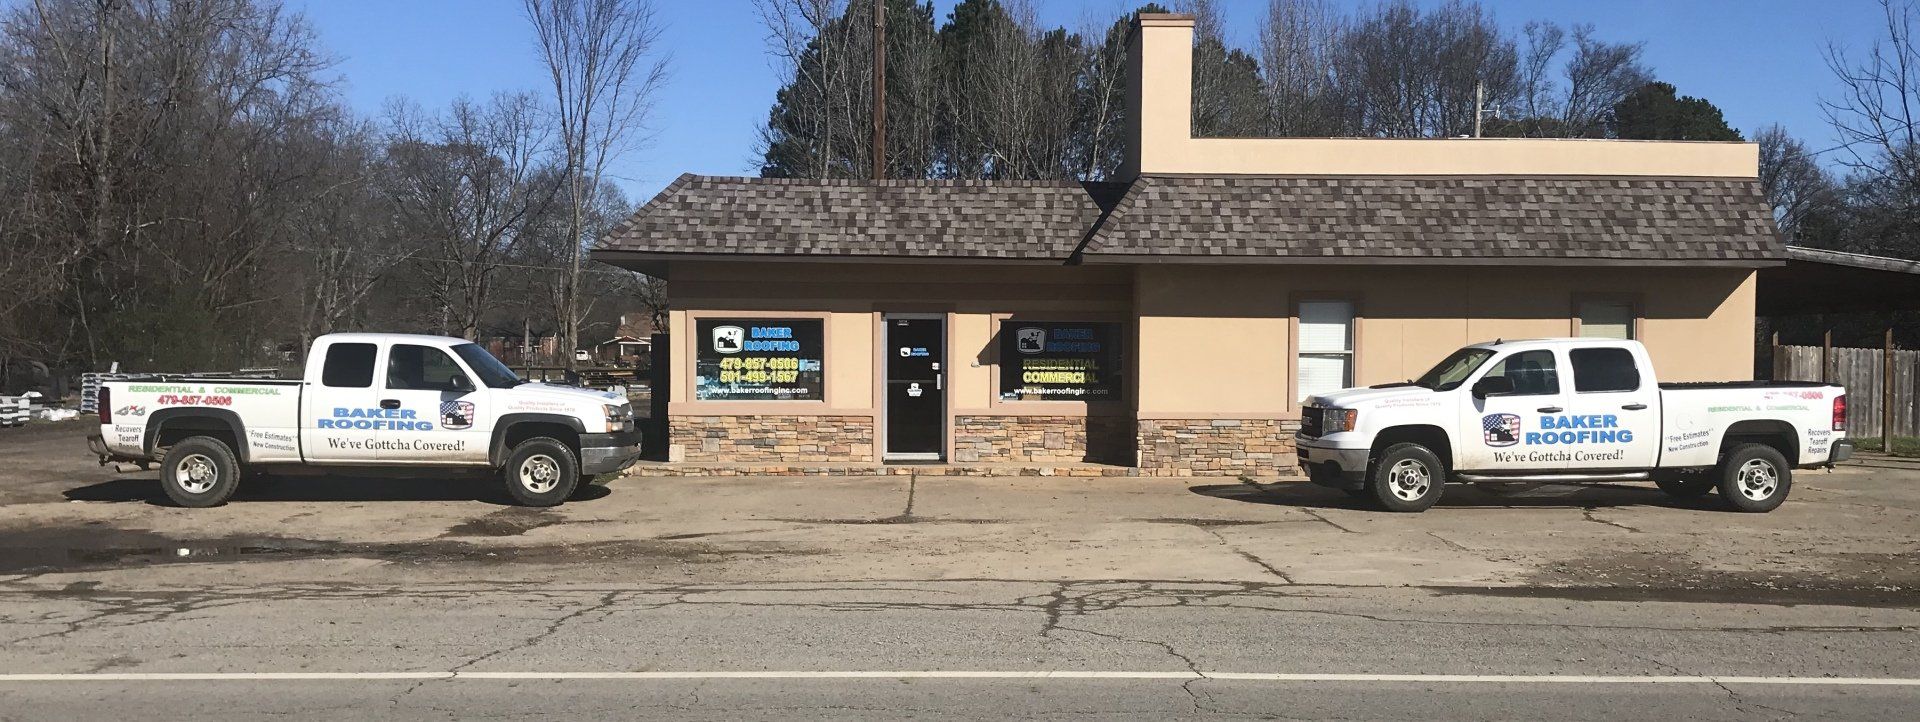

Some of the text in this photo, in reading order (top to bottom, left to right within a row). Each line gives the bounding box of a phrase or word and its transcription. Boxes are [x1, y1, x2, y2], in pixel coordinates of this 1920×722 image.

[751, 327, 793, 338] BAKER
[1053, 328, 1094, 339] BAKER
[743, 340, 800, 351] ROOFING
[719, 357, 799, 370] 479-857-0506
[1022, 358, 1099, 370] RESIDENTIAL
[719, 370, 799, 383] 501-499-1567
[1022, 371, 1099, 383] COMMERCIAL
[128, 385, 194, 394] RESIDENTIAL
[213, 386, 281, 395] COMMERCIAL
[710, 386, 808, 396] www.bakerroofinginc.com
[157, 394, 233, 406] 479-857-0506
[333, 407, 418, 420] BAKER
[317, 418, 434, 432] ROOFING
[1540, 414, 1618, 429] BAKER
[114, 424, 143, 434] Recovers
[1807, 428, 1831, 436] Recovers
[1525, 430, 1634, 446] ROOFING
[266, 442, 296, 451] Construction
[328, 437, 465, 452] We've Gottcha Covered!
[1668, 440, 1709, 453] New Construction
[1807, 446, 1828, 454] Repairs
[1494, 448, 1625, 464] We've Gottcha Covered!
